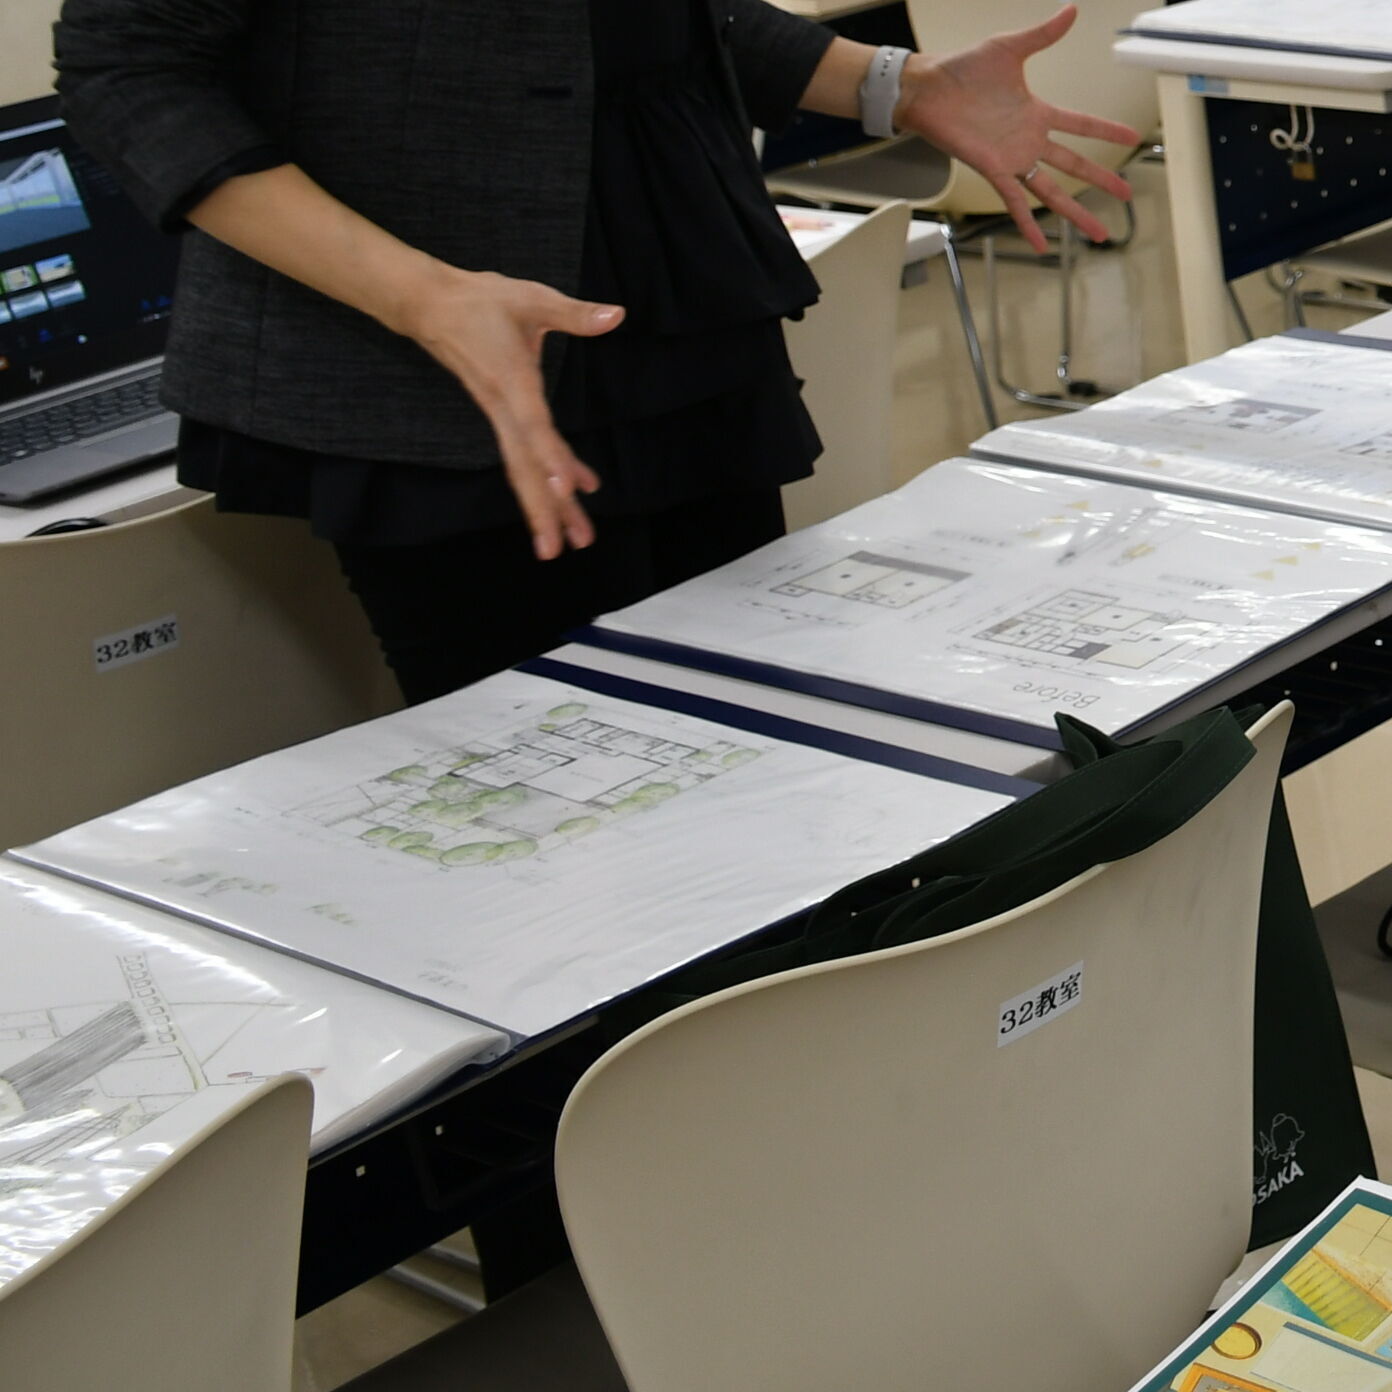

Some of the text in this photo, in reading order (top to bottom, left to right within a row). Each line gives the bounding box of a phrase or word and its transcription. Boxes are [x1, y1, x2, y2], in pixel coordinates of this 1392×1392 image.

[97, 621, 177, 664] 32教室
[1012, 681, 1102, 710] Before
[1000, 971, 1081, 1035] 32教室
